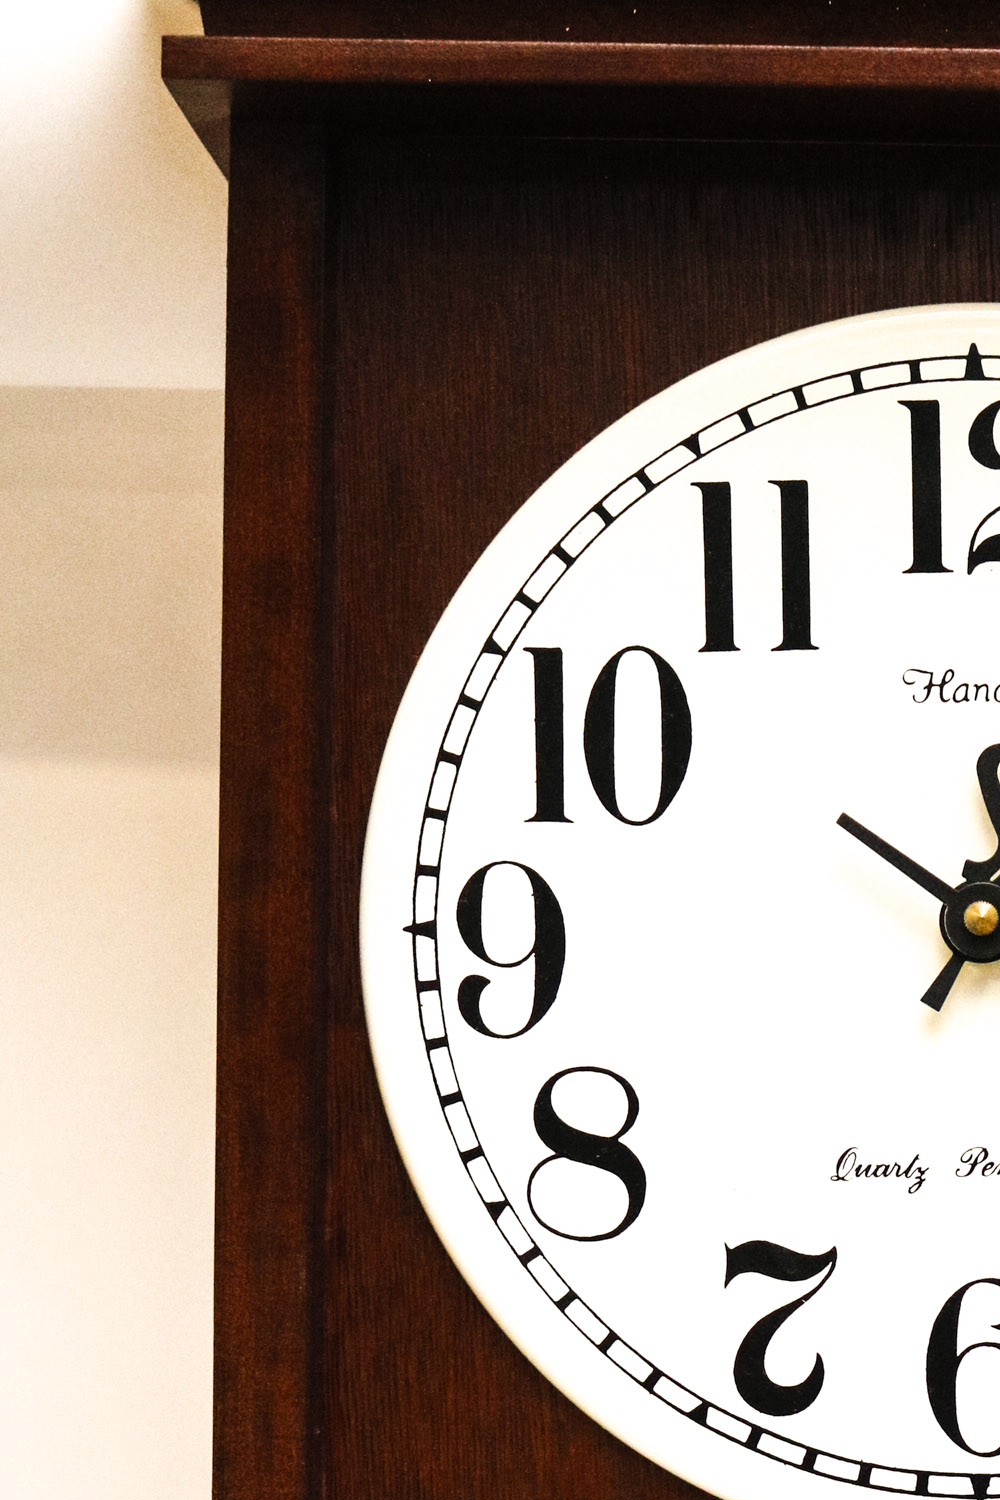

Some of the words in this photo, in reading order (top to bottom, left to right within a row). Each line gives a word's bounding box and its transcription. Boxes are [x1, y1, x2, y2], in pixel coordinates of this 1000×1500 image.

[691, 480, 819, 652] 11
[523, 646, 692, 826] 10
[457, 861, 565, 1039] 9
[527, 1067, 646, 1242] 8
[830, 1146, 930, 1194] Quartz
[725, 1240, 837, 1416] 7
